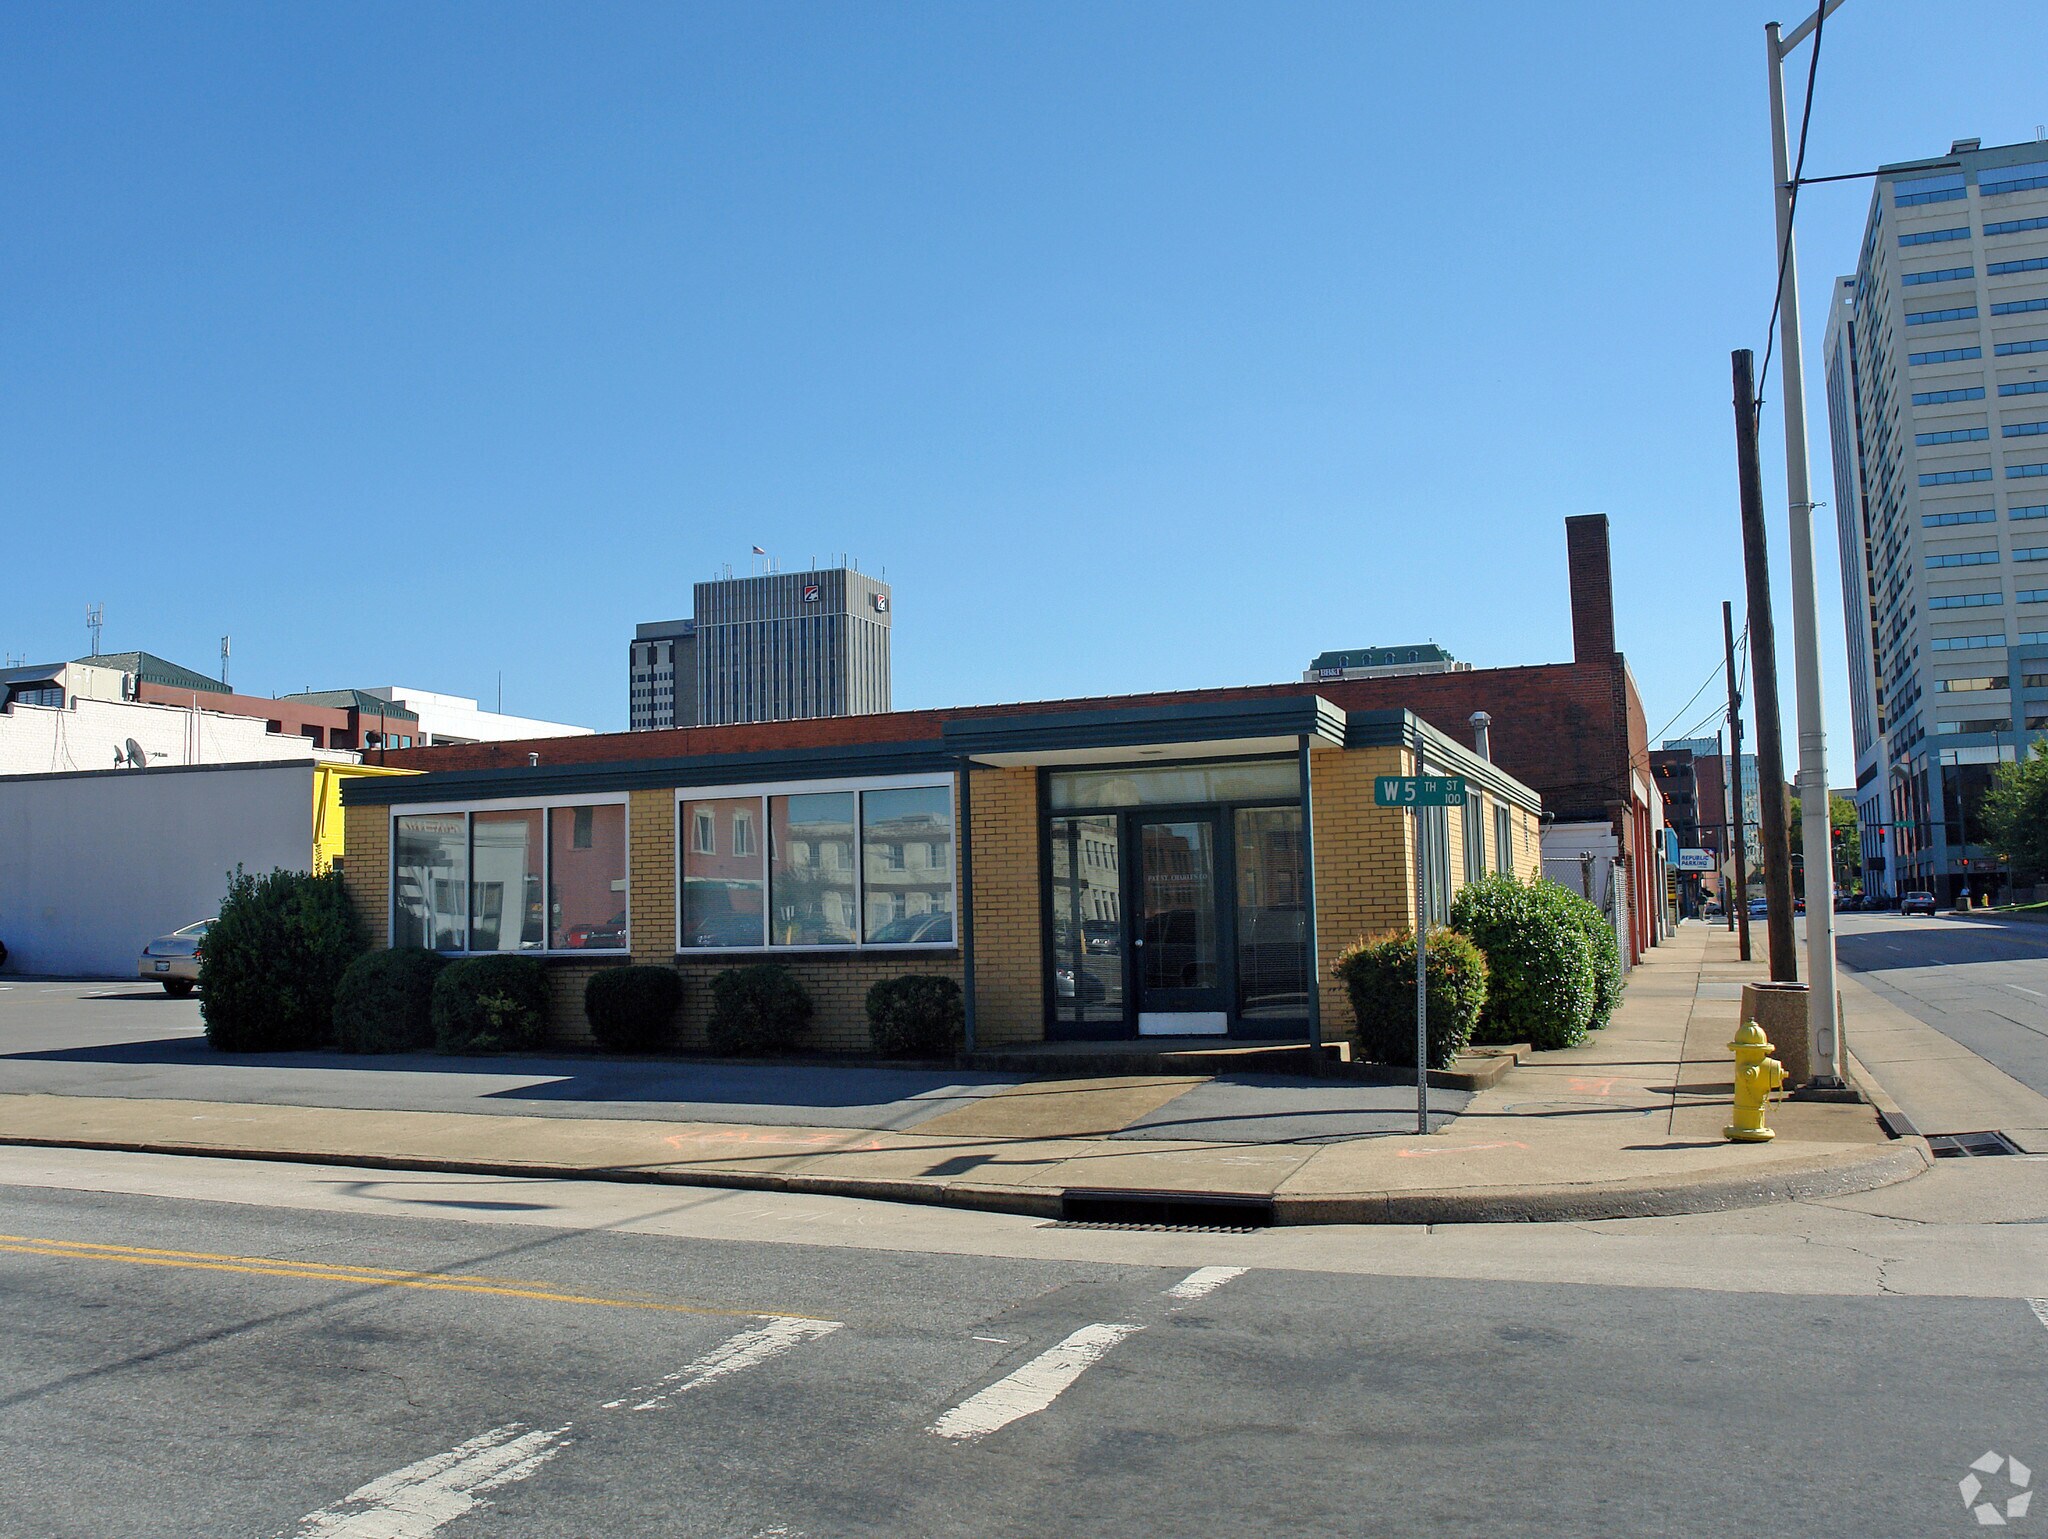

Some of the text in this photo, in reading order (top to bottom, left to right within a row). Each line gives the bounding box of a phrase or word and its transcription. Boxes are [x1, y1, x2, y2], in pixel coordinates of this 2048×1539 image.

[1383, 781, 1399, 801] W
[1424, 781, 1437, 792] TH
[1446, 780, 1458, 791] ST
[1445, 793, 1460, 804] 100
